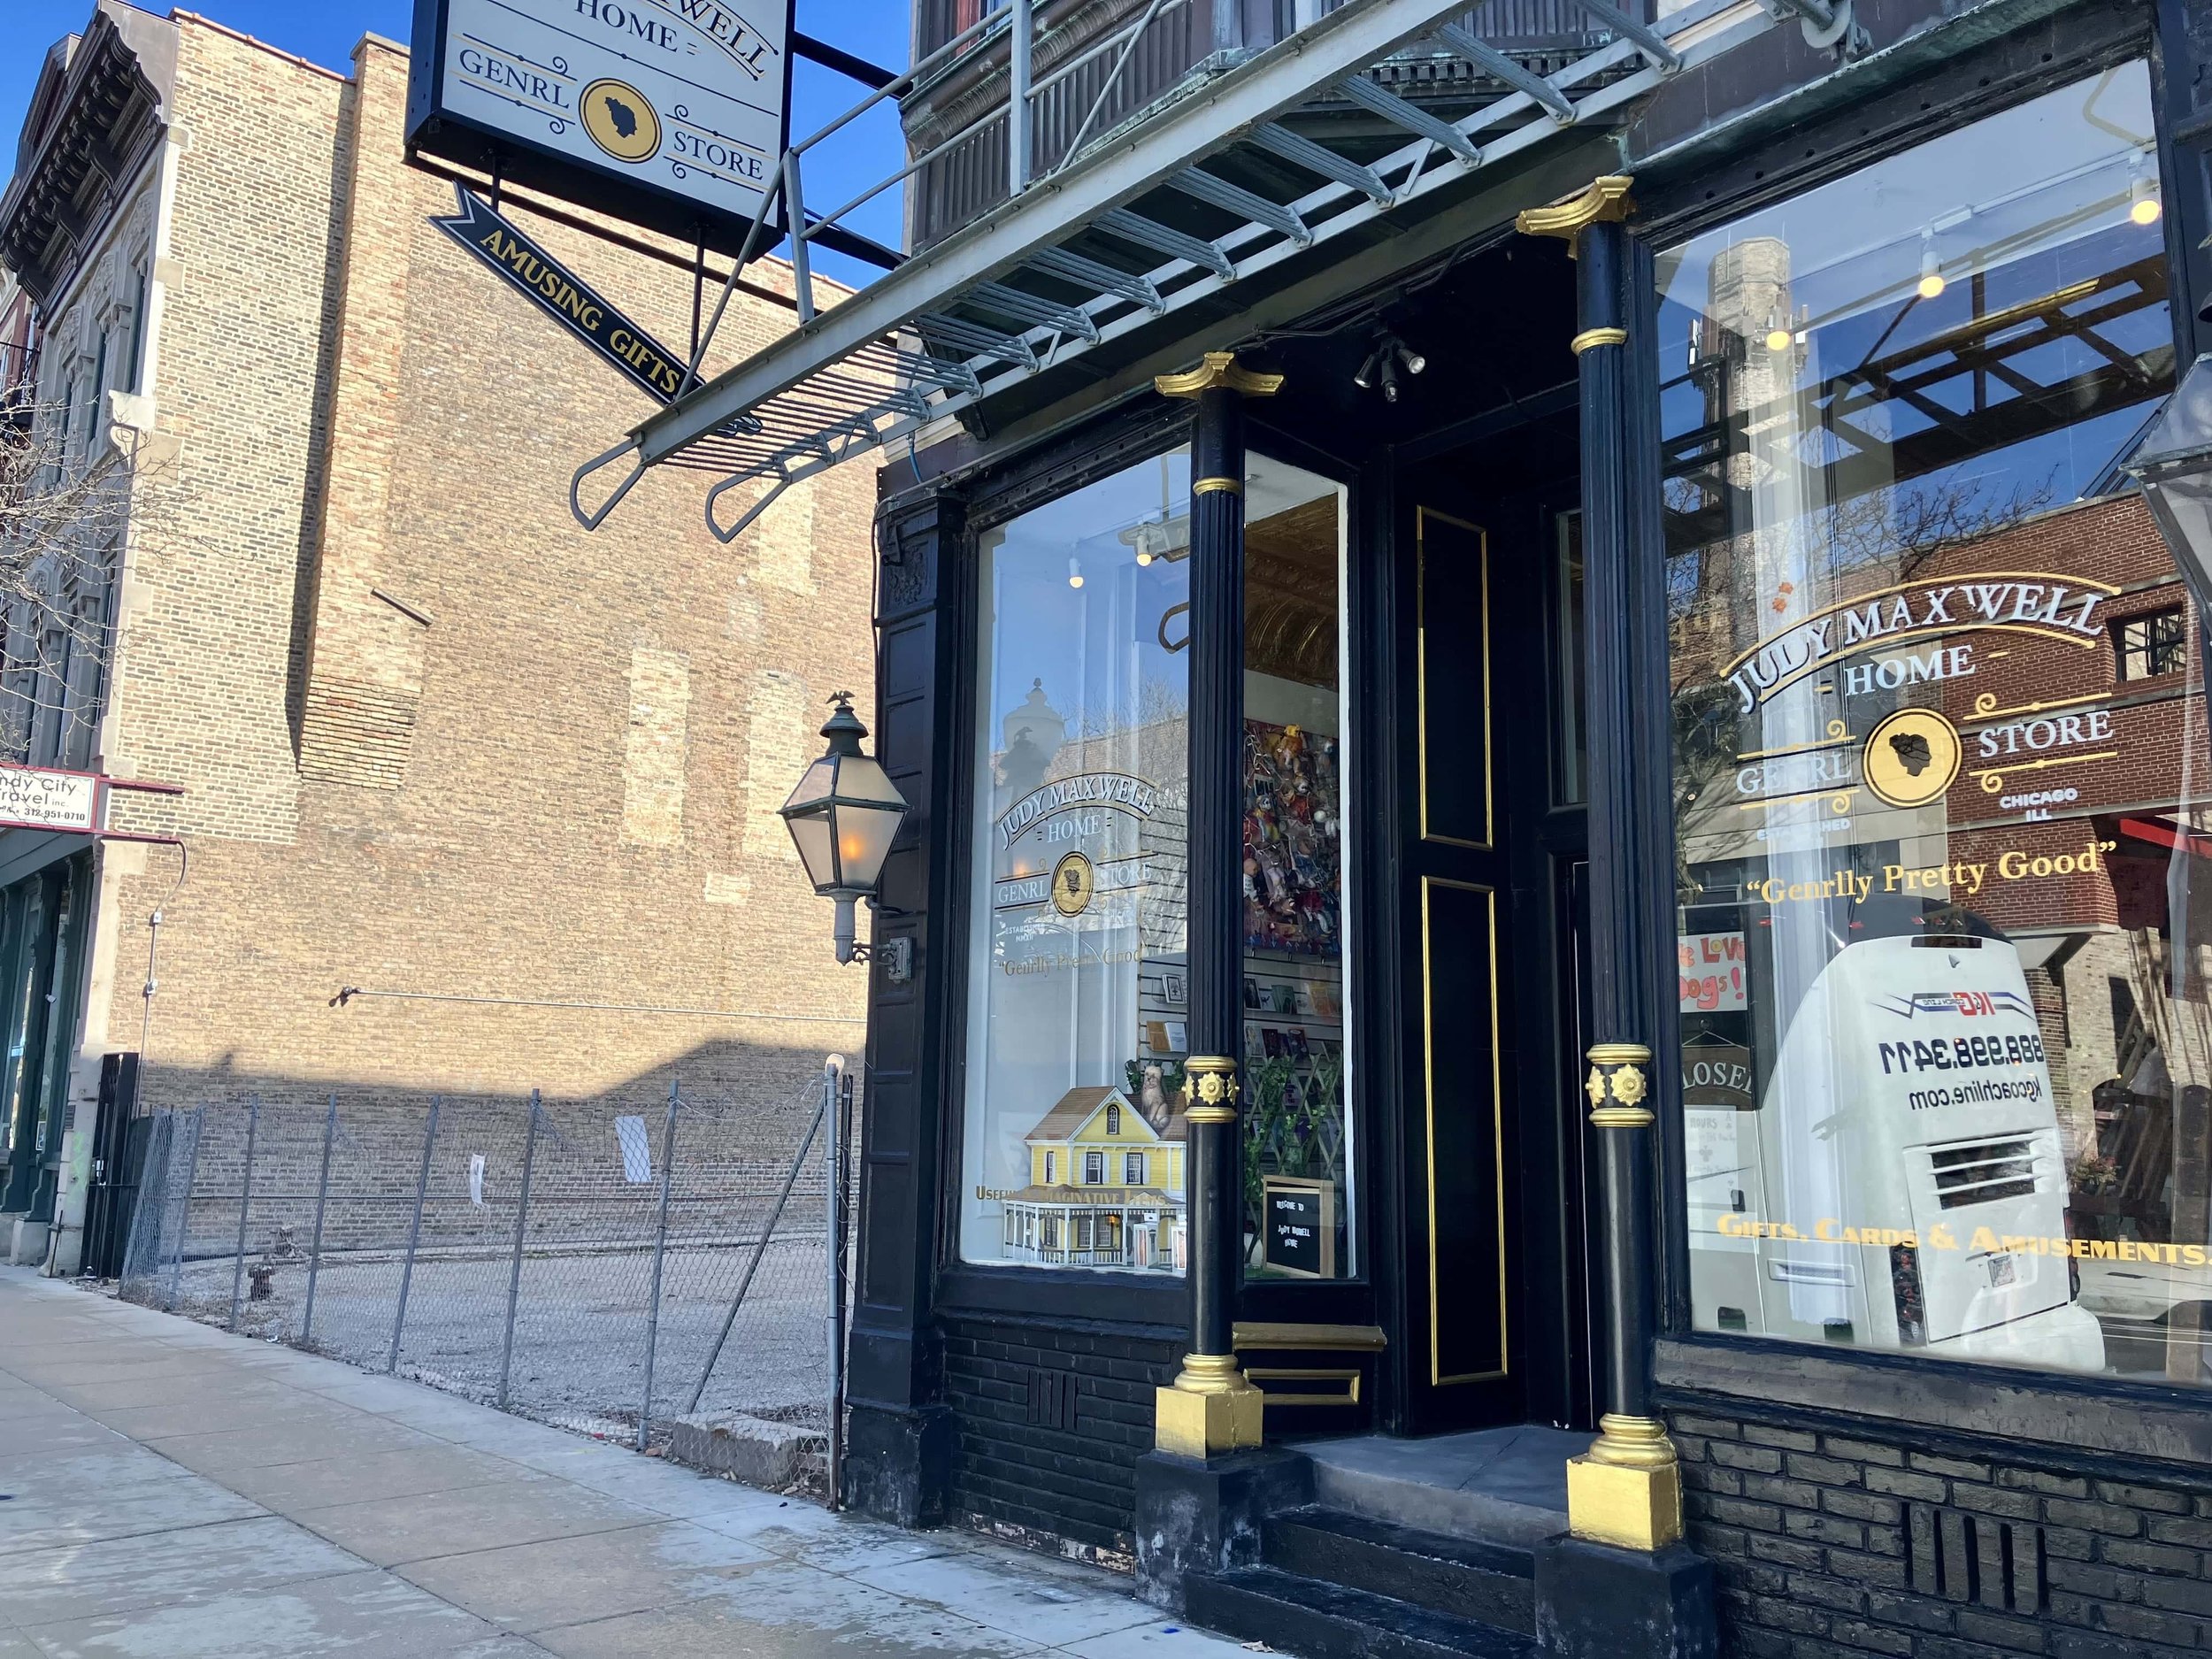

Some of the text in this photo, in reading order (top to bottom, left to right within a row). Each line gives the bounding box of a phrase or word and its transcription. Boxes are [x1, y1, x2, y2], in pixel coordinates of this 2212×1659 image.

[574, 0, 679, 53] HOME
[666, 0, 767, 74] WELL
[459, 48, 570, 110] GENRL
[673, 131, 764, 180] STORE
[480, 229, 680, 395] AMUSING GIFTS
[1726, 583, 2105, 715] JUDY MAXWELL
[1845, 644, 1977, 697] HOME
[1979, 710, 2115, 760] STORE
[42, 778, 77, 796] City
[1736, 749, 1853, 795] GERL
[0, 787, 49, 805] ravel
[999, 775, 1155, 851] JUDY MAXWELL
[2000, 787, 2079, 810] CHICAGO
[24, 807, 86, 821] 312-951-0710
[1048, 814, 1102, 843] HOME
[2026, 808, 2053, 822] ILL
[998, 879, 1048, 903] GENRL
[1101, 862, 1152, 887] TORE
[1882, 859, 1990, 895] Pretty
[1678, 942, 1694, 967] e
[976, 1185, 1017, 1201] USEF
[1048, 1190, 1120, 1205] MAGINATIVE
[1814, 1217, 1919, 1248] CARDS
[1930, 1221, 1960, 1251] &
